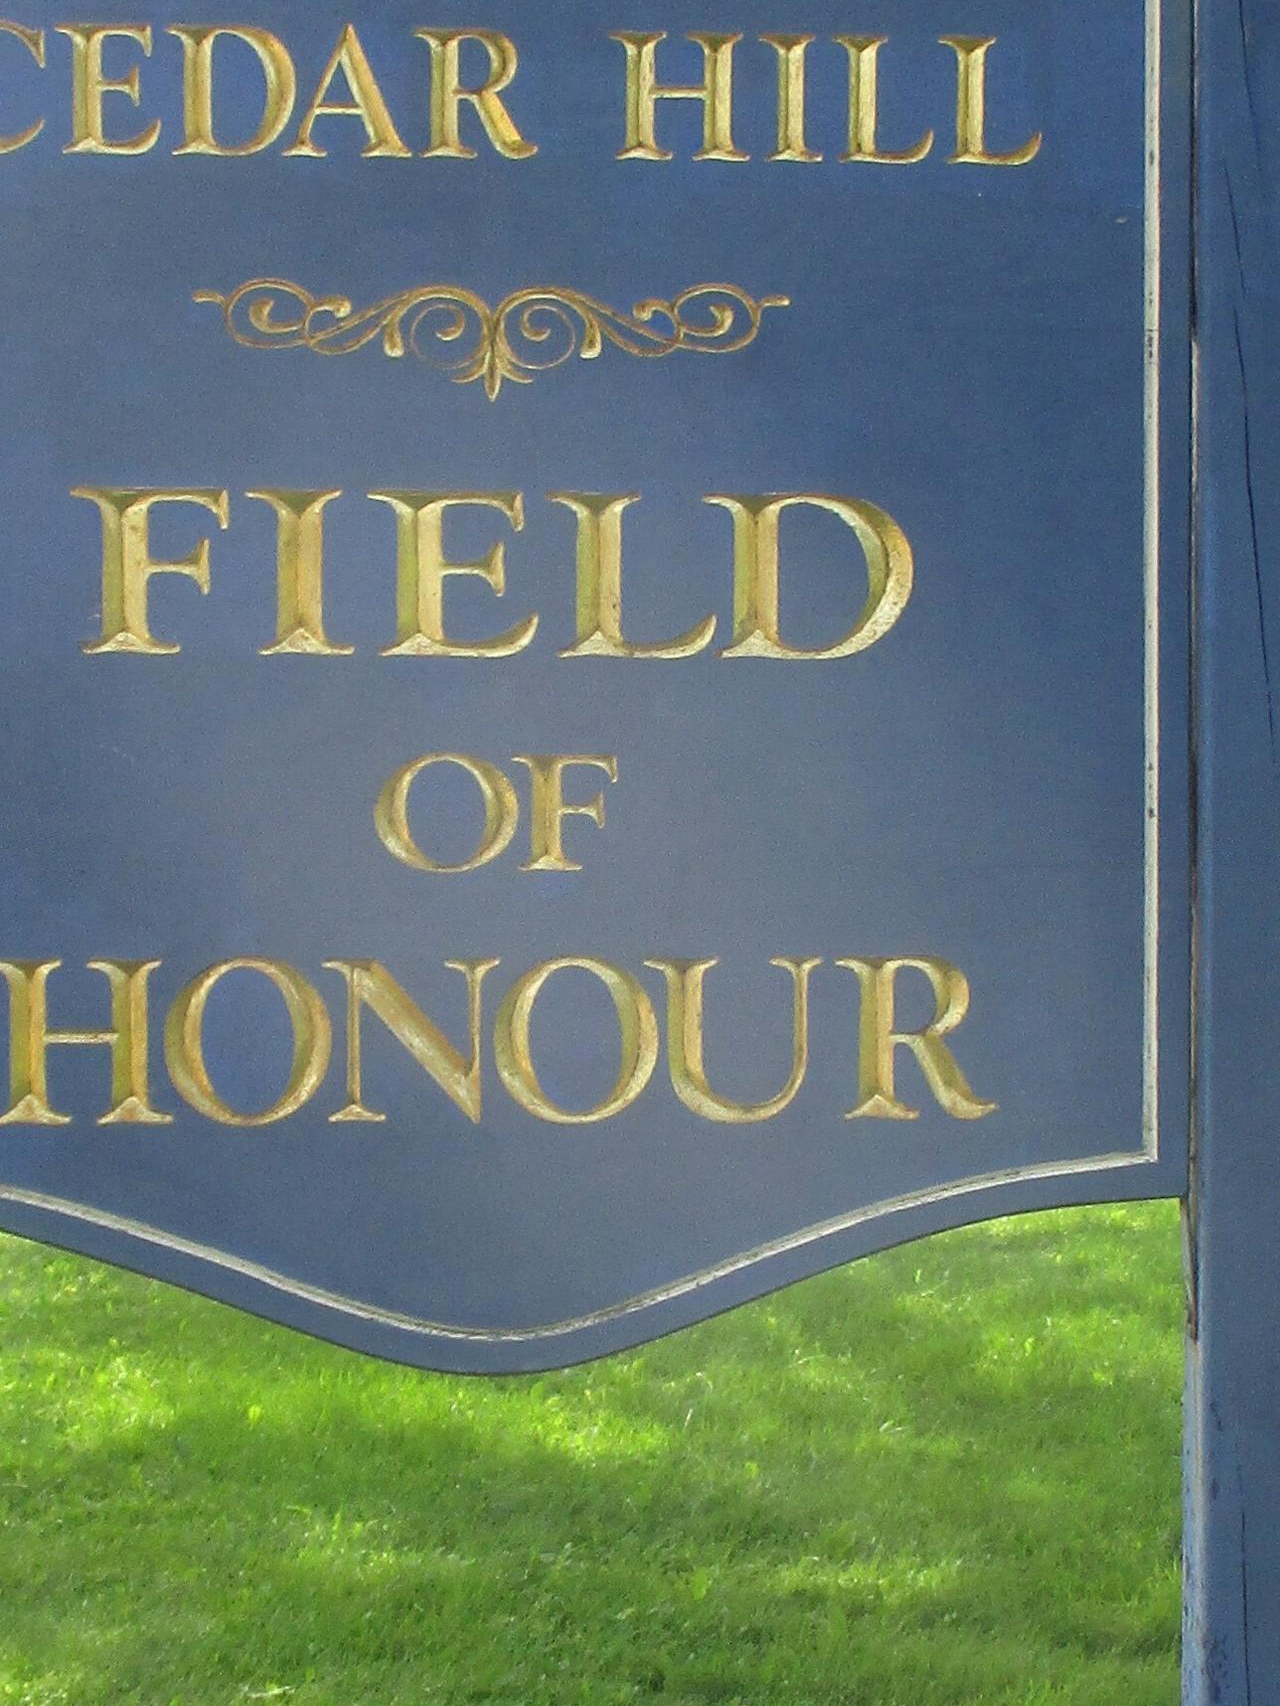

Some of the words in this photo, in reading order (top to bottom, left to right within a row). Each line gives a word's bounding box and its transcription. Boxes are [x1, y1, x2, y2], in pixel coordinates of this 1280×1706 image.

[615, 31, 1043, 165] HILL
[70, 485, 915, 661] FIELD
[373, 752, 620, 873] OF
